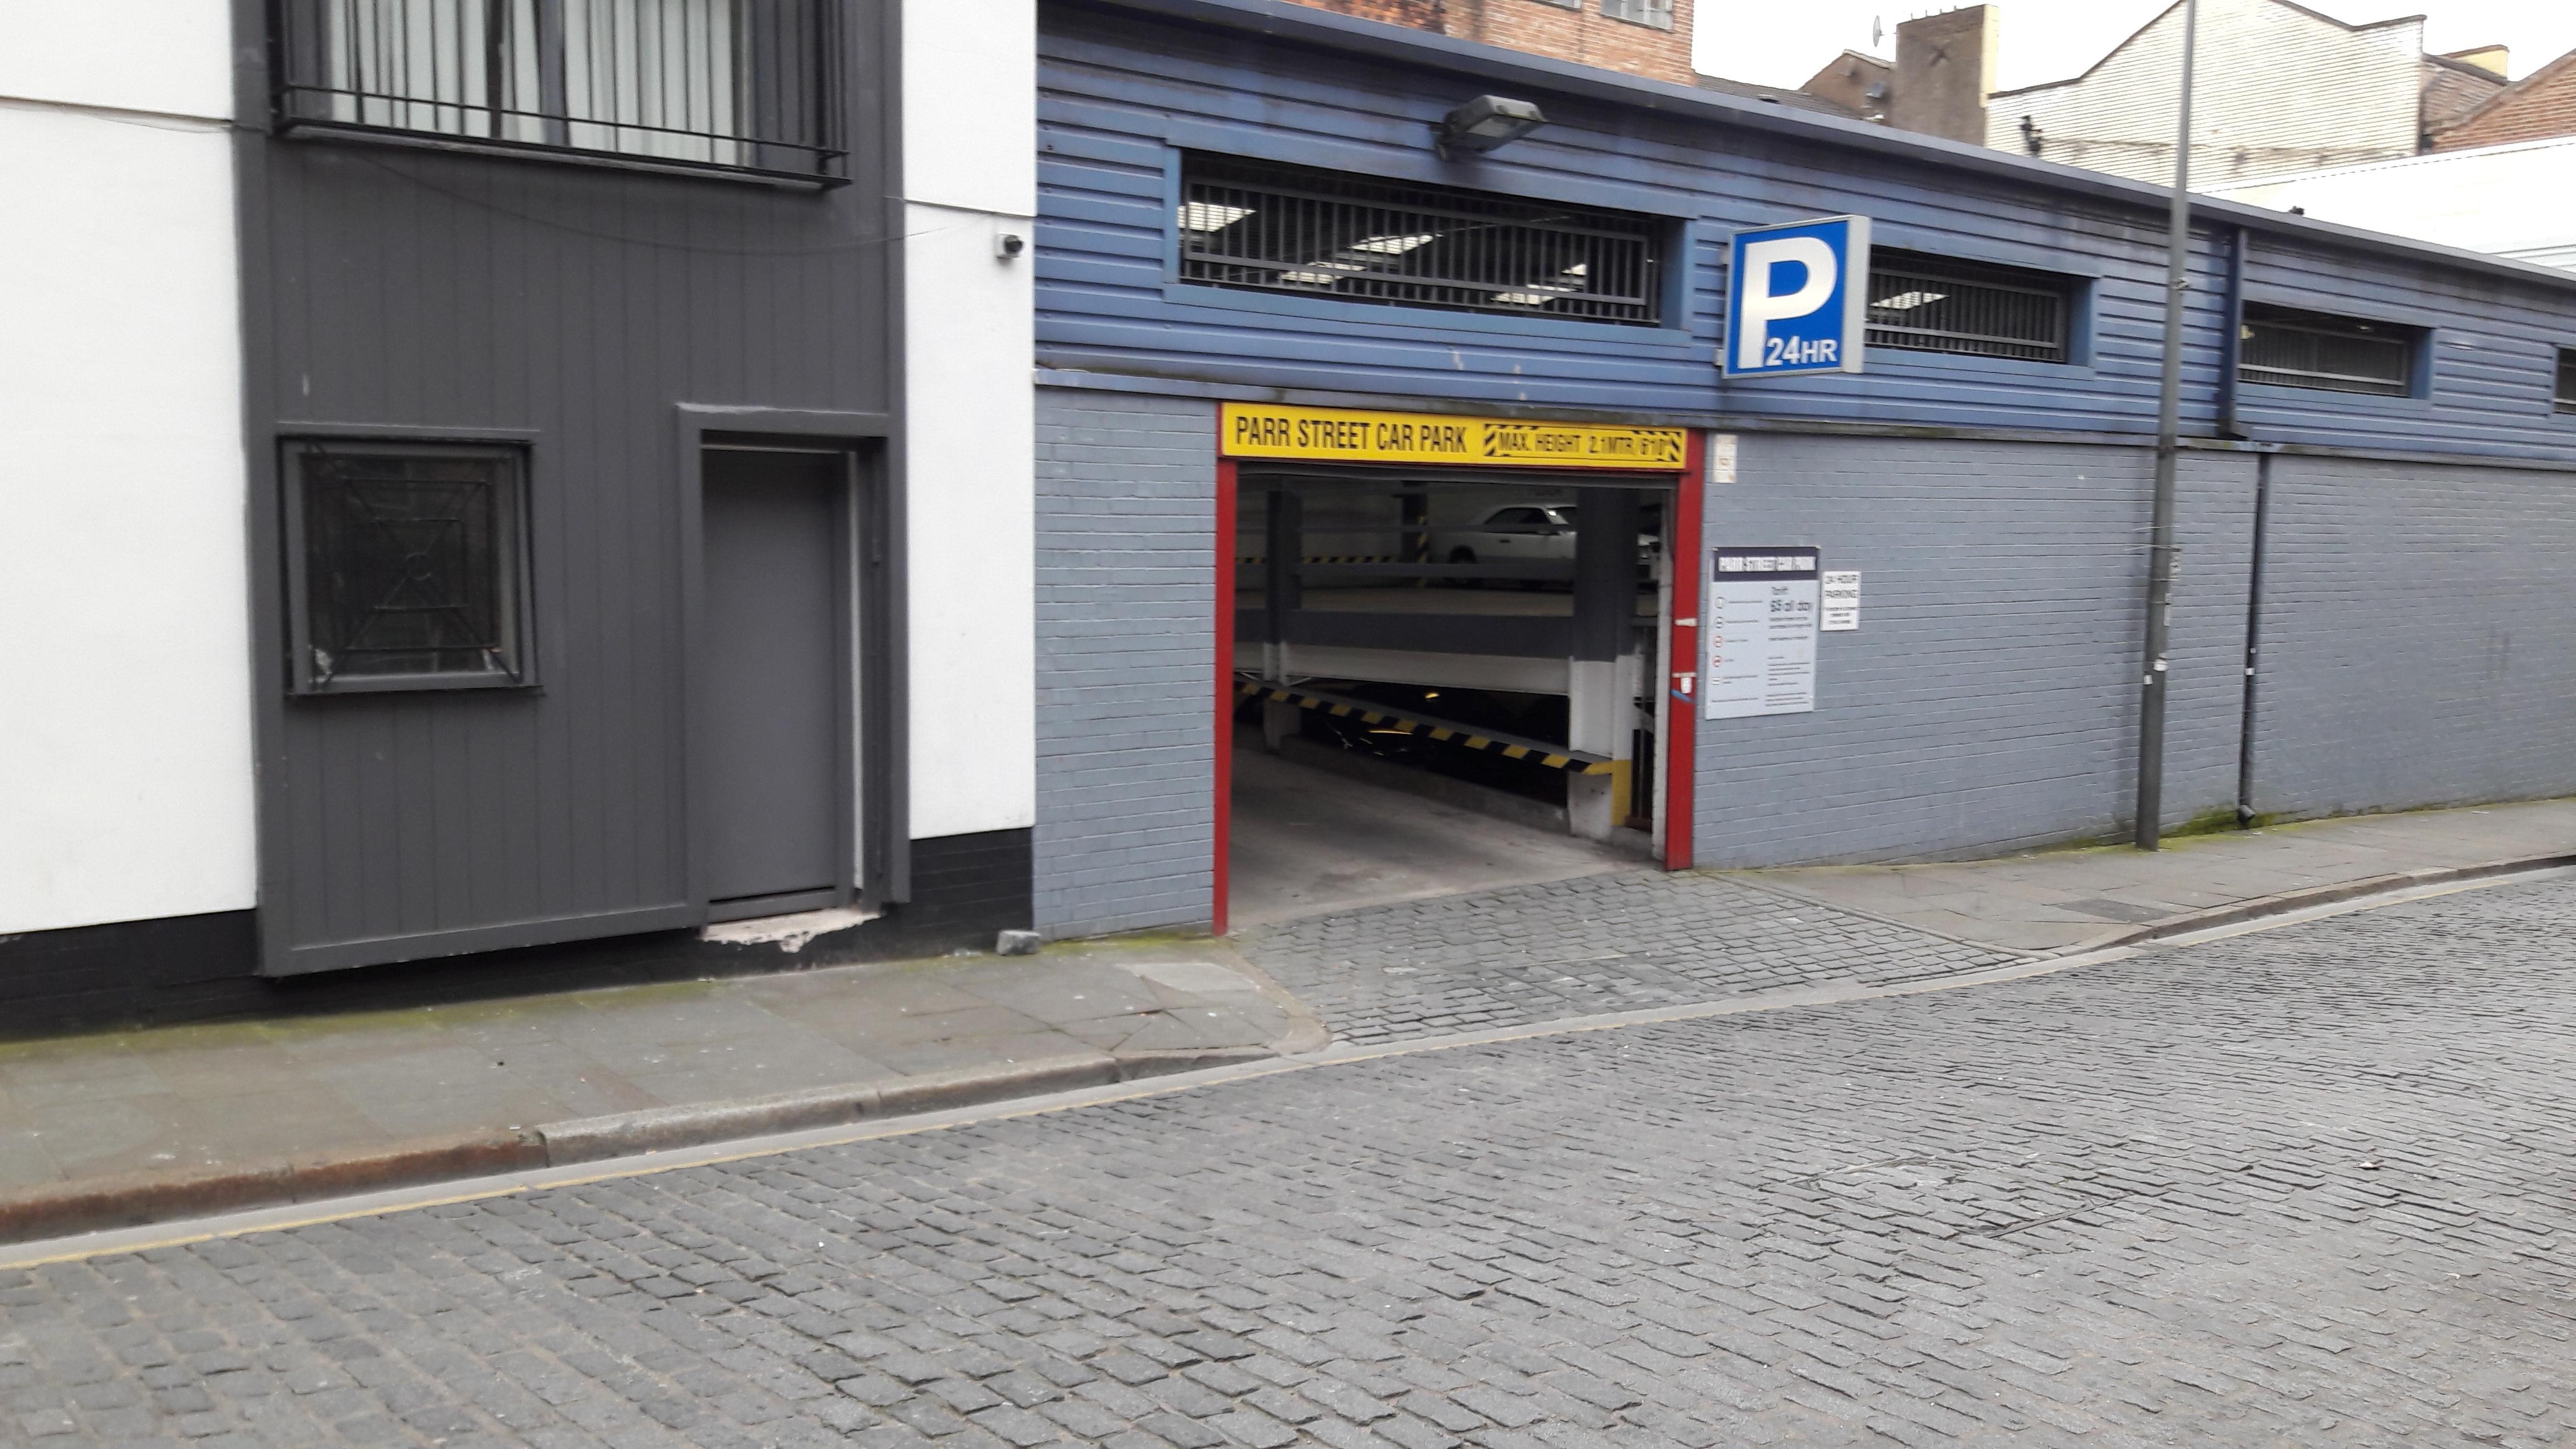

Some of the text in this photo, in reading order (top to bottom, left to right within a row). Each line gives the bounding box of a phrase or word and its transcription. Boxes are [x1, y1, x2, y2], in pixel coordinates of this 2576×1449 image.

[1737, 237, 1838, 369] P
[1765, 335, 1838, 366] 24HR
[1236, 416, 1467, 453] PARR STREET CAR PARK
[1534, 434, 1581, 454] HEIGHT
